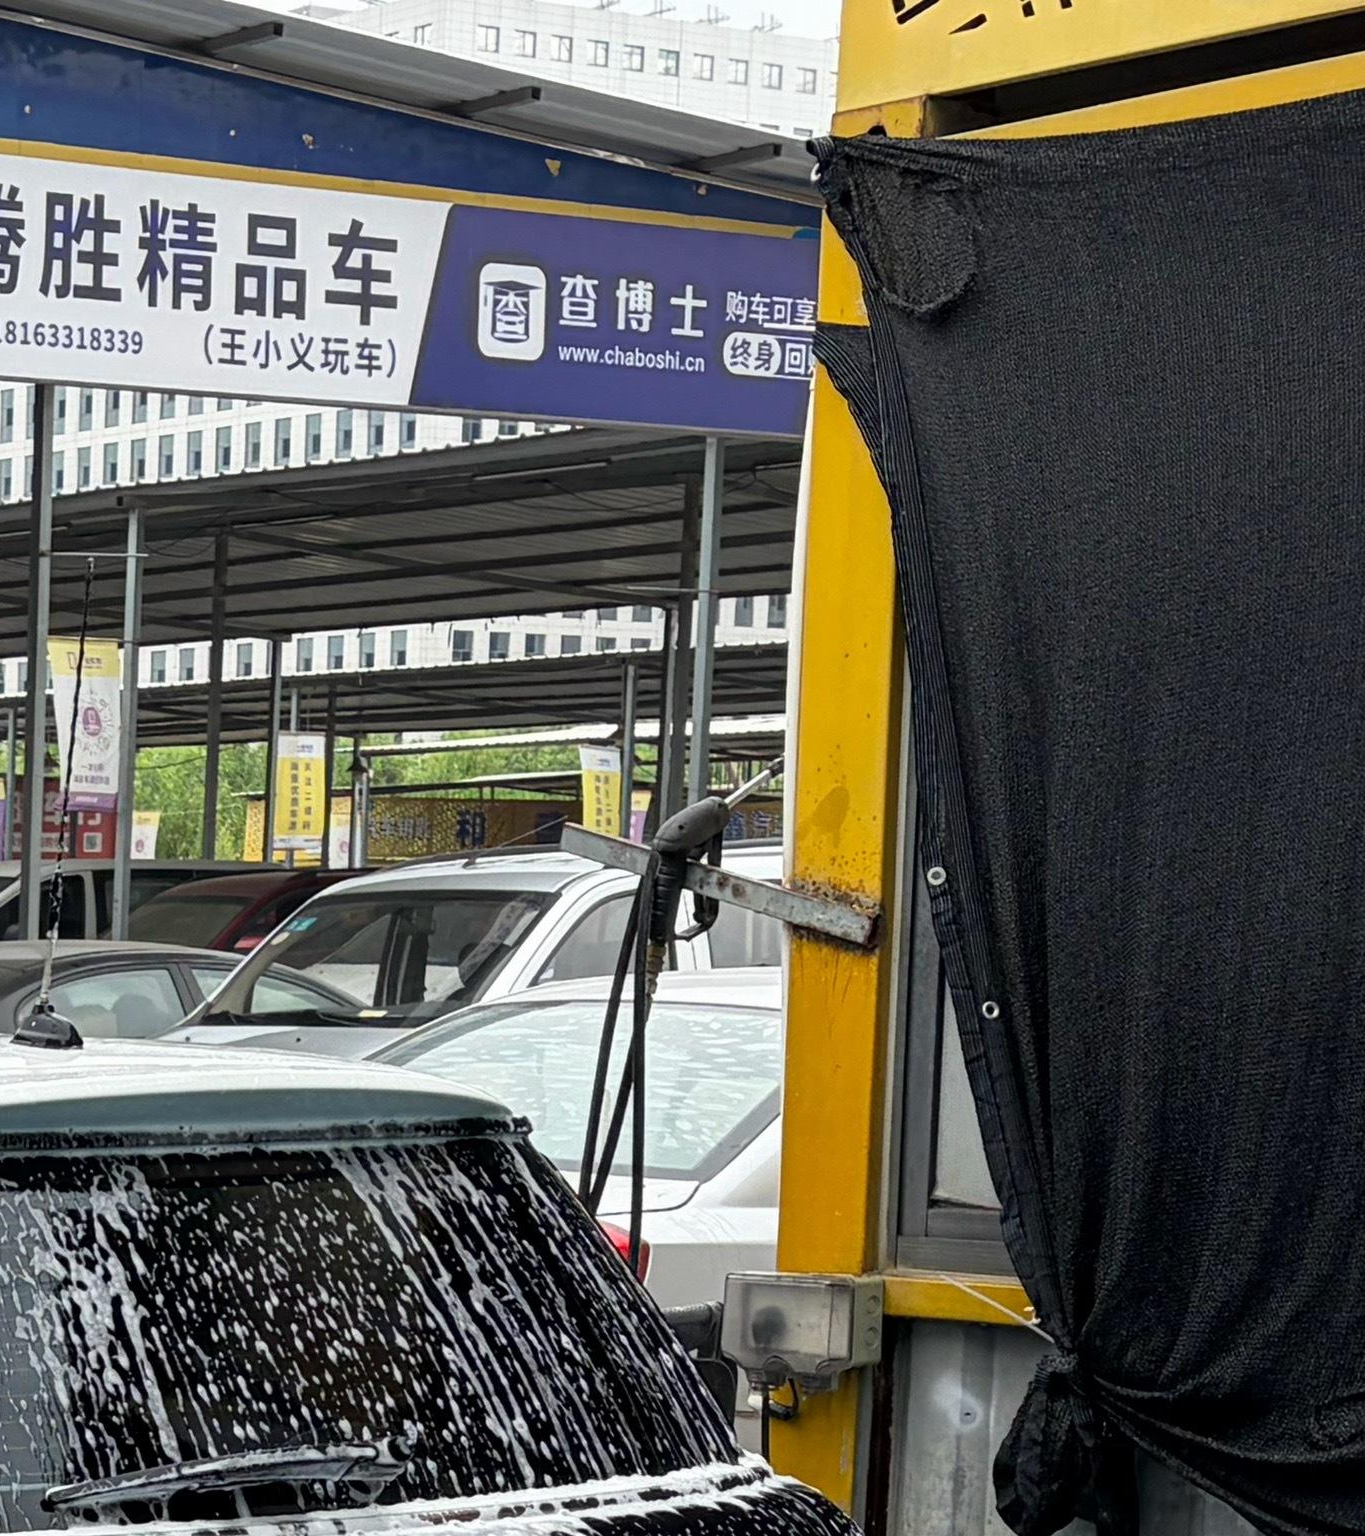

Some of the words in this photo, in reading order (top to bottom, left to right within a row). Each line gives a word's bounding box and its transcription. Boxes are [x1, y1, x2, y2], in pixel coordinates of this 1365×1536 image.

[557, 272, 709, 339] 查博士
[557, 343, 707, 374] www.chaboshi.cn
